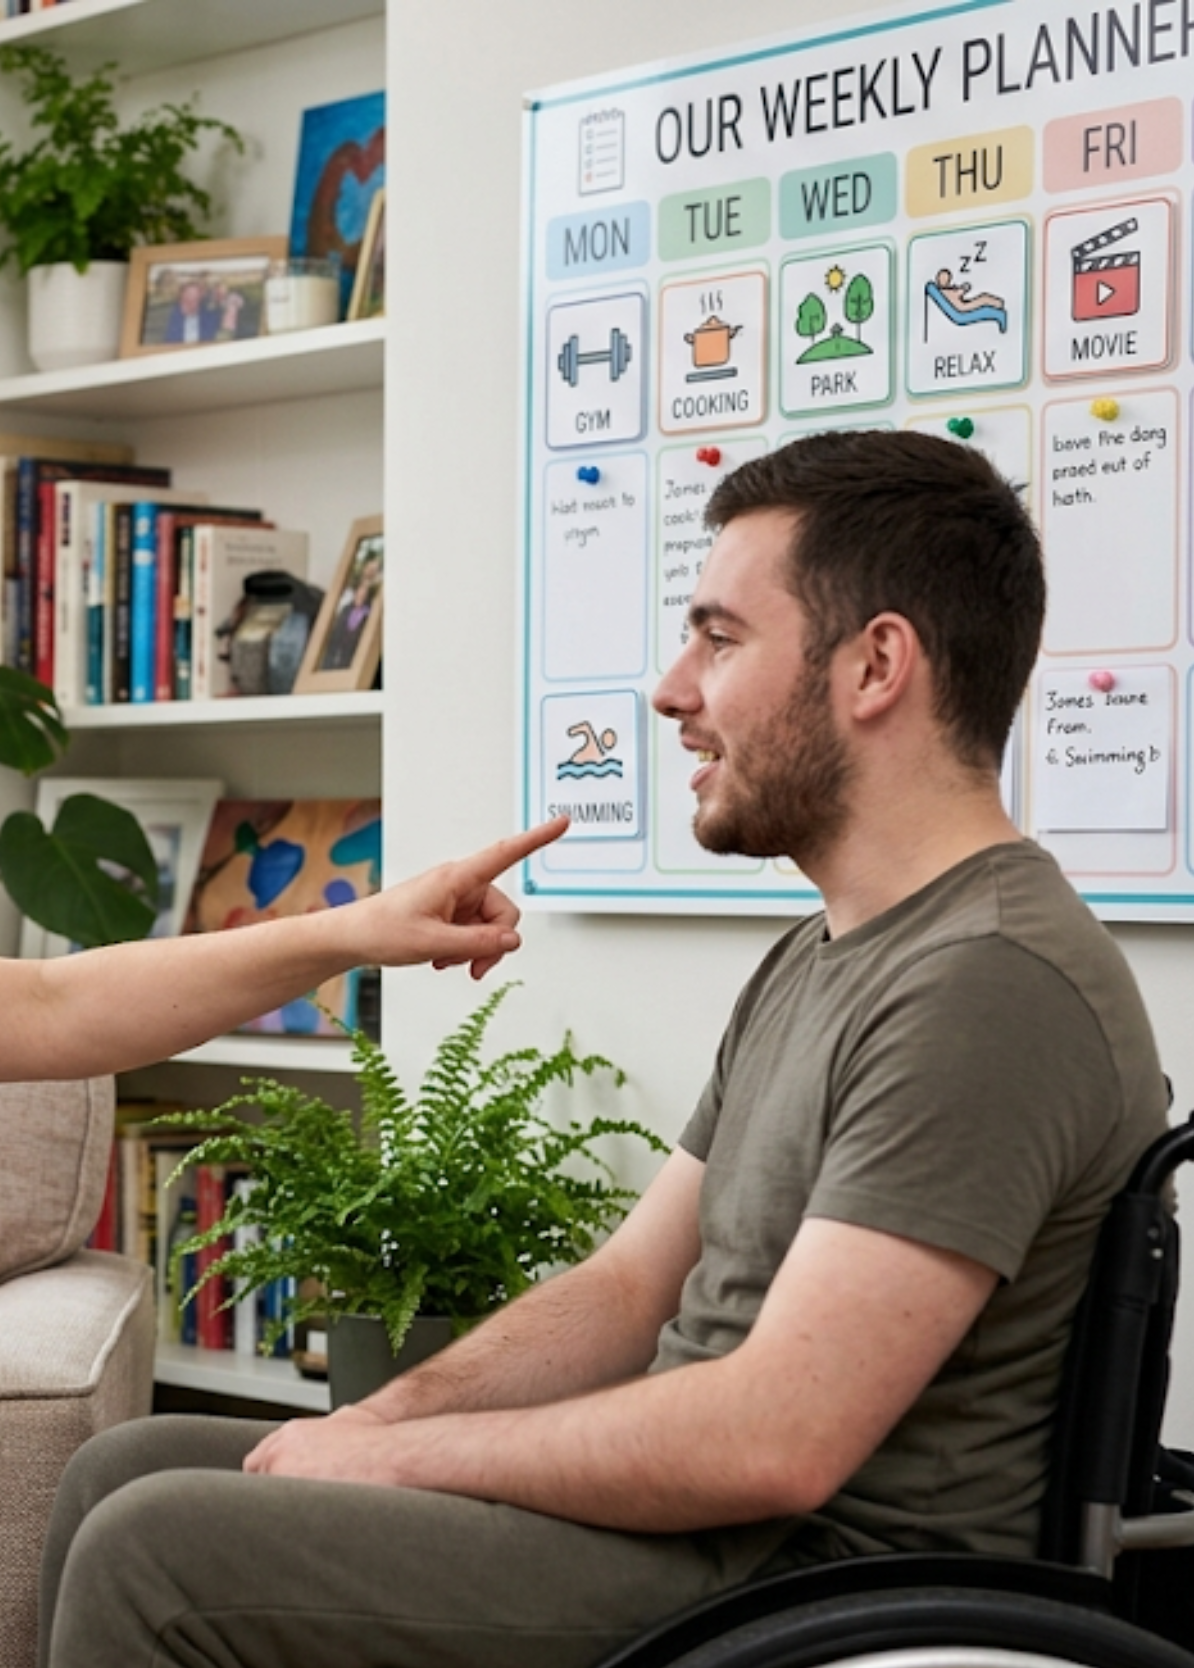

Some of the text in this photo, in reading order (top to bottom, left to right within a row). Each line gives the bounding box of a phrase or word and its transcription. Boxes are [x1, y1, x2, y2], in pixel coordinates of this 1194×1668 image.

[655, 93, 743, 165] OUR
[760, 46, 943, 143] WEEKLY
[1083, 119, 1136, 173] FRI
[933, 145, 1003, 199] THU
[801, 171, 872, 223] WED
[684, 197, 742, 244] TUE
[564, 217, 630, 267] MON
[934, 350, 996, 379] RELAX
[1071, 330, 1138, 361] MOVIE
[810, 371, 859, 398] PARK
[575, 409, 611, 434] GYM
[672, 390, 749, 419] COOKING
[1133, 451, 1151, 471] of
